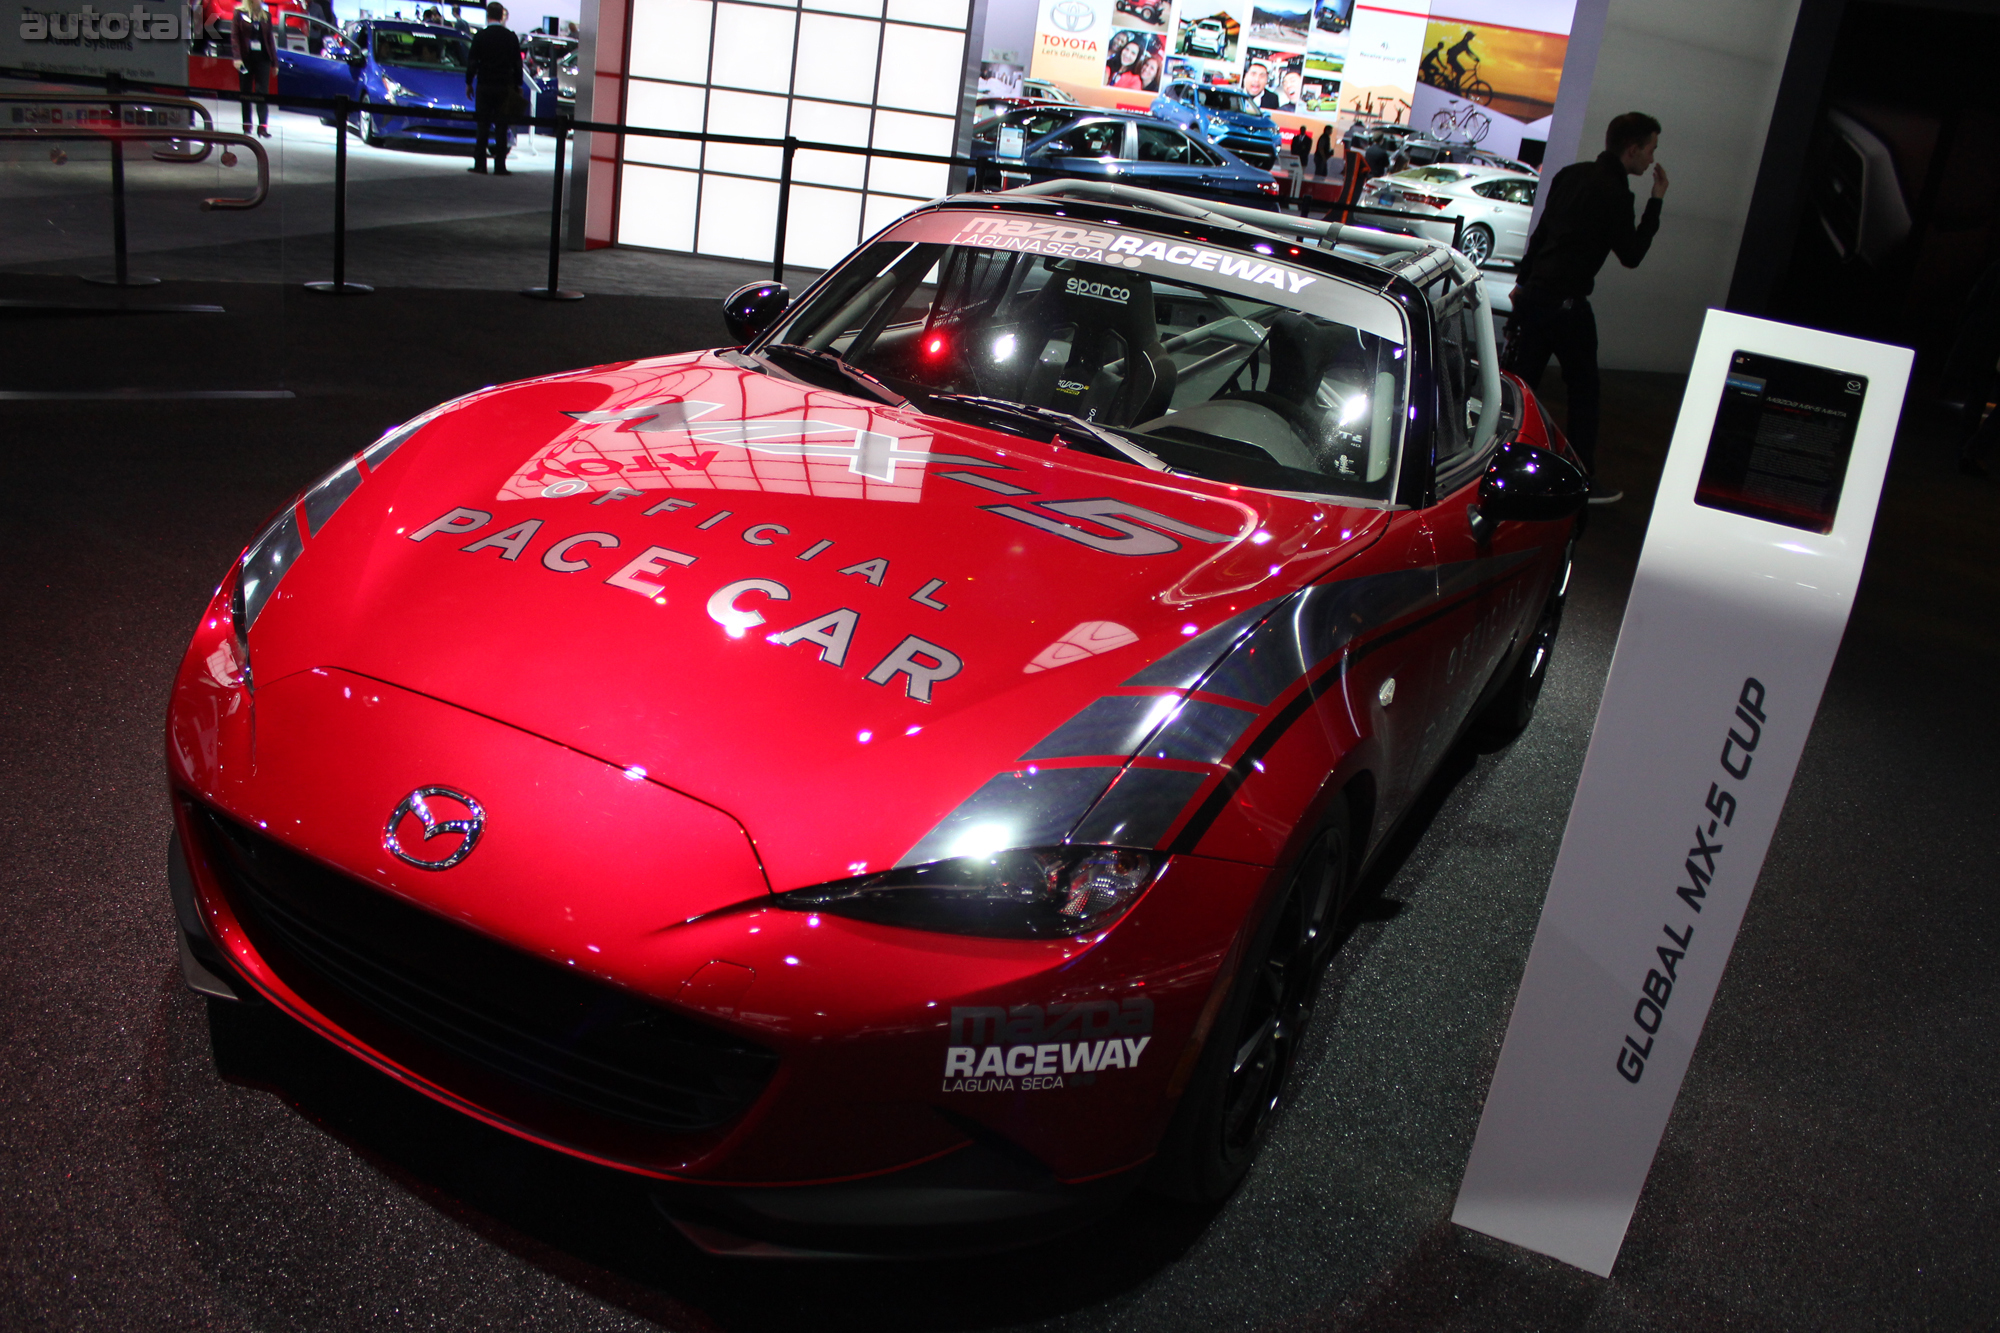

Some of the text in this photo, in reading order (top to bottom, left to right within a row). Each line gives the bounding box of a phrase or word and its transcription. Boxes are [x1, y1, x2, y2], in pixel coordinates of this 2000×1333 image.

[1042, 34, 1097, 52] TOYOTA
[950, 232, 1105, 262] LAGUNA SECA
[1109, 234, 1317, 294] RACEWAY
[1066, 277, 1130, 303] sparco
[541, 480, 950, 611] OFFICIAL
[408, 507, 964, 705] PACE CAR
[1616, 677, 1767, 1085] GLOBAL MX-5 CUP
[944, 1036, 1152, 1077] RACEWAY
[942, 1075, 1064, 1092] LAGUNA SECA
